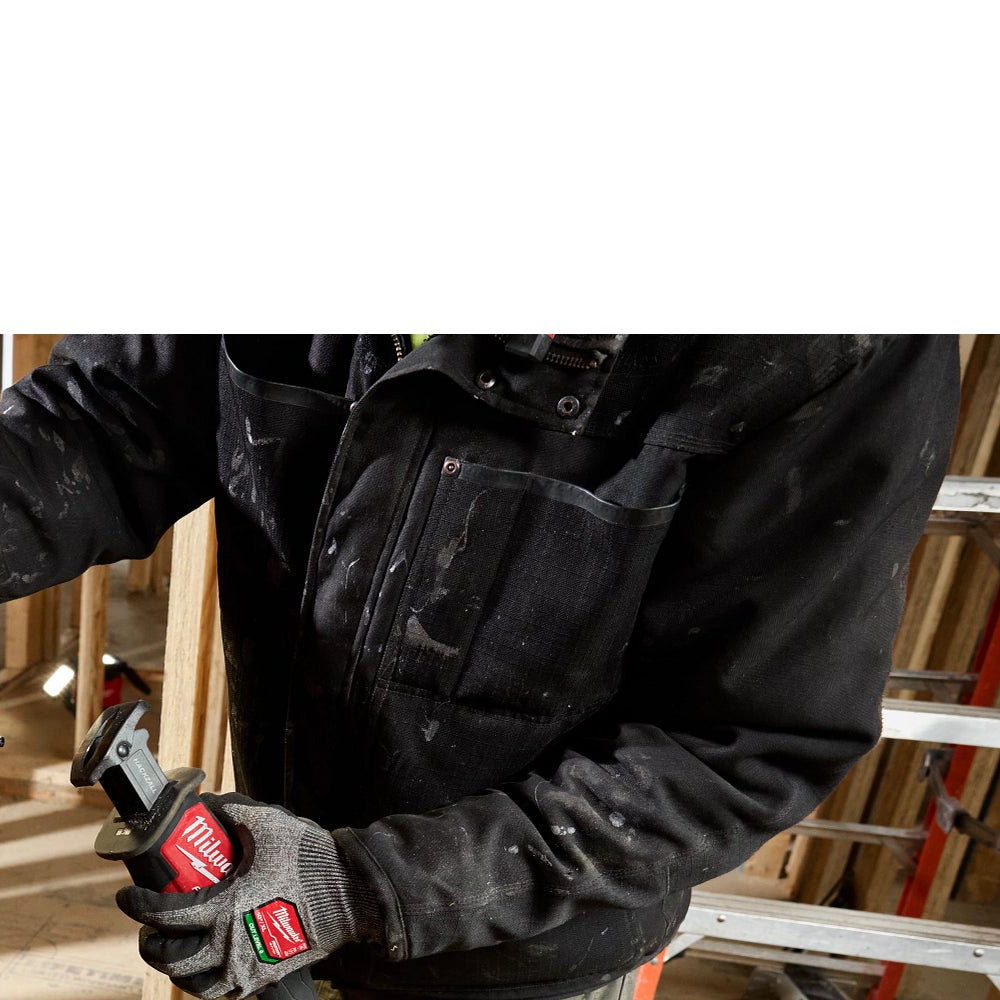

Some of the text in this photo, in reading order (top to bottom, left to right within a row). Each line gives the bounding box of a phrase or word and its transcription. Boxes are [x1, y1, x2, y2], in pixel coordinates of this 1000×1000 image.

[133, 758, 158, 795] HACKZALL
[182, 815, 233, 874] Milwa
[248, 922, 257, 935] CUT
[272, 905, 303, 943] Milwaukee
